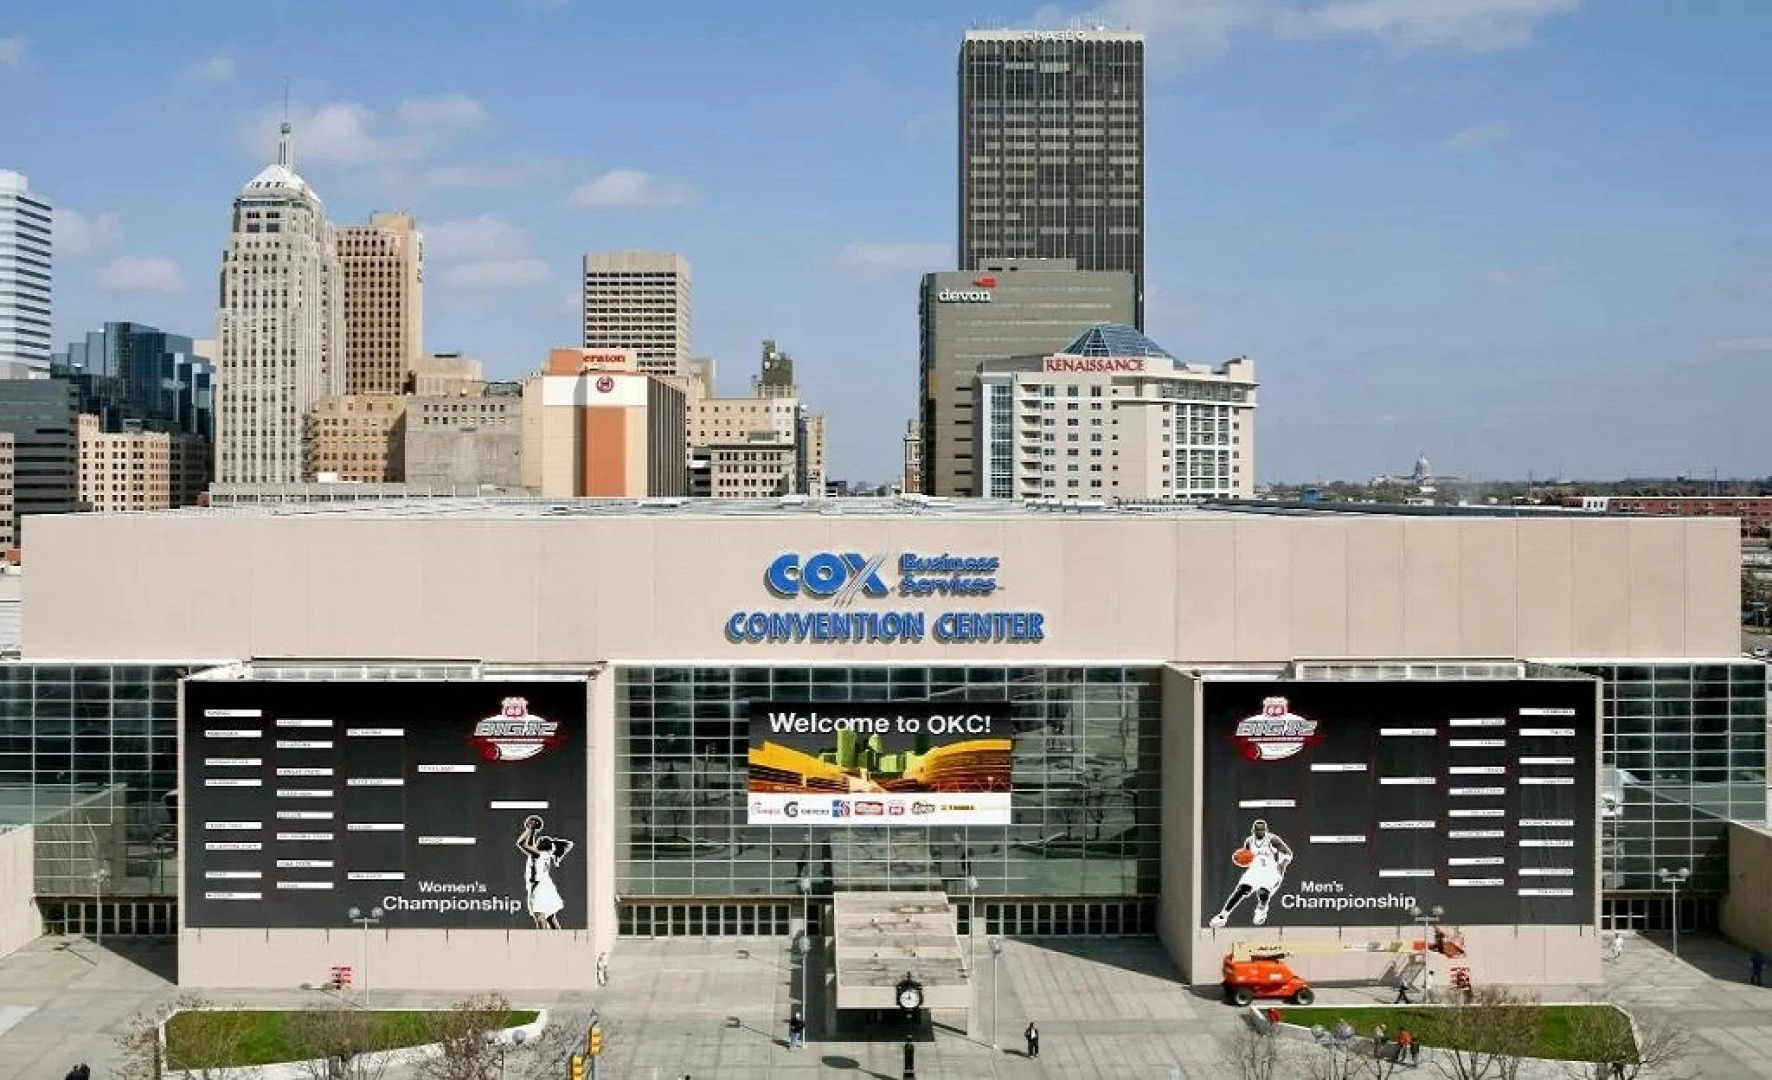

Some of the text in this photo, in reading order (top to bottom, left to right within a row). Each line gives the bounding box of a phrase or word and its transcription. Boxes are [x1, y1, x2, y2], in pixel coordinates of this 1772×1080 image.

[939, 288, 991, 302] devon
[1045, 358, 1145, 372] RENAISSANCE
[900, 552, 999, 573] Business
[766, 552, 888, 599] COX
[900, 574, 997, 595] Services
[727, 611, 1046, 642] CONVENTION CENTER
[768, 712, 992, 734] Welcome to OKC!
[418, 880, 487, 893] Women's
[1300, 880, 1344, 893] Men's
[382, 895, 522, 915] Championship
[1281, 892, 1416, 912] Championship
